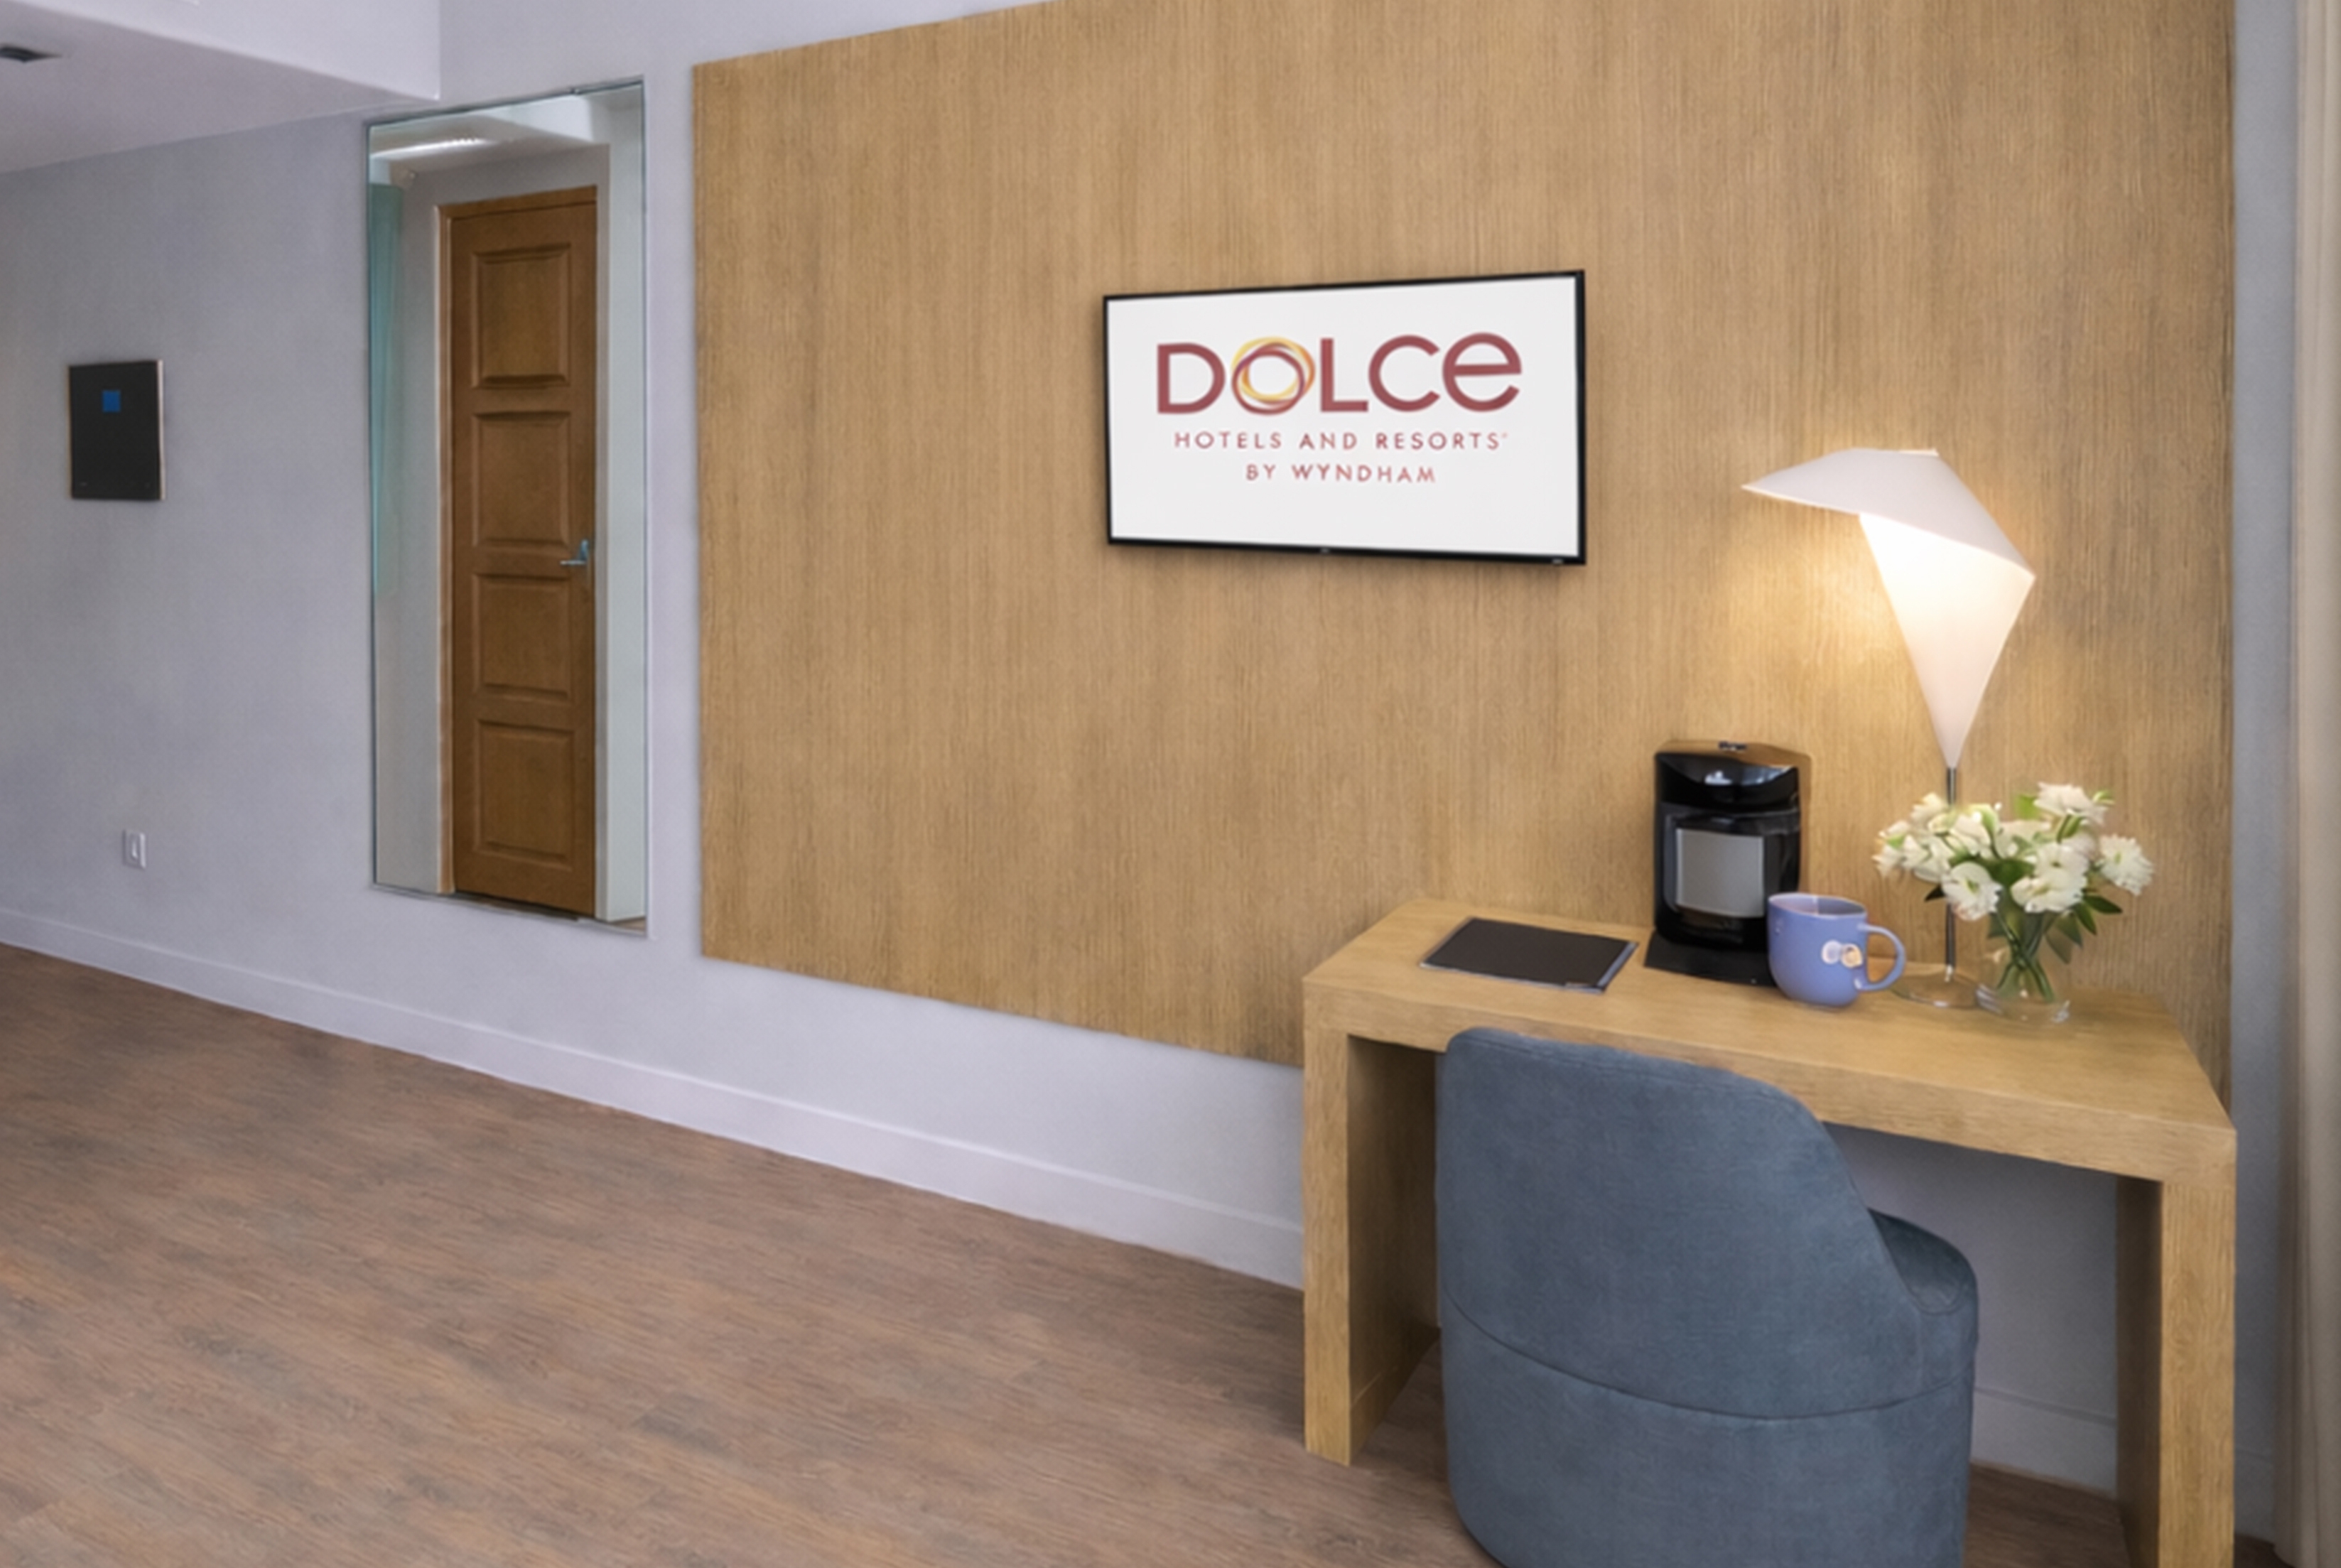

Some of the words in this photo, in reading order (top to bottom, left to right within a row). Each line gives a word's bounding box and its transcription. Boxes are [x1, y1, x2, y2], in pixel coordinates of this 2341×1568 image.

[1174, 431, 1281, 450] HOTELS
[1300, 433, 1357, 450] AND
[1376, 432, 1501, 450] RESORTS
[1246, 464, 1276, 481] BY
[1292, 465, 1435, 483] WYNDHAM
